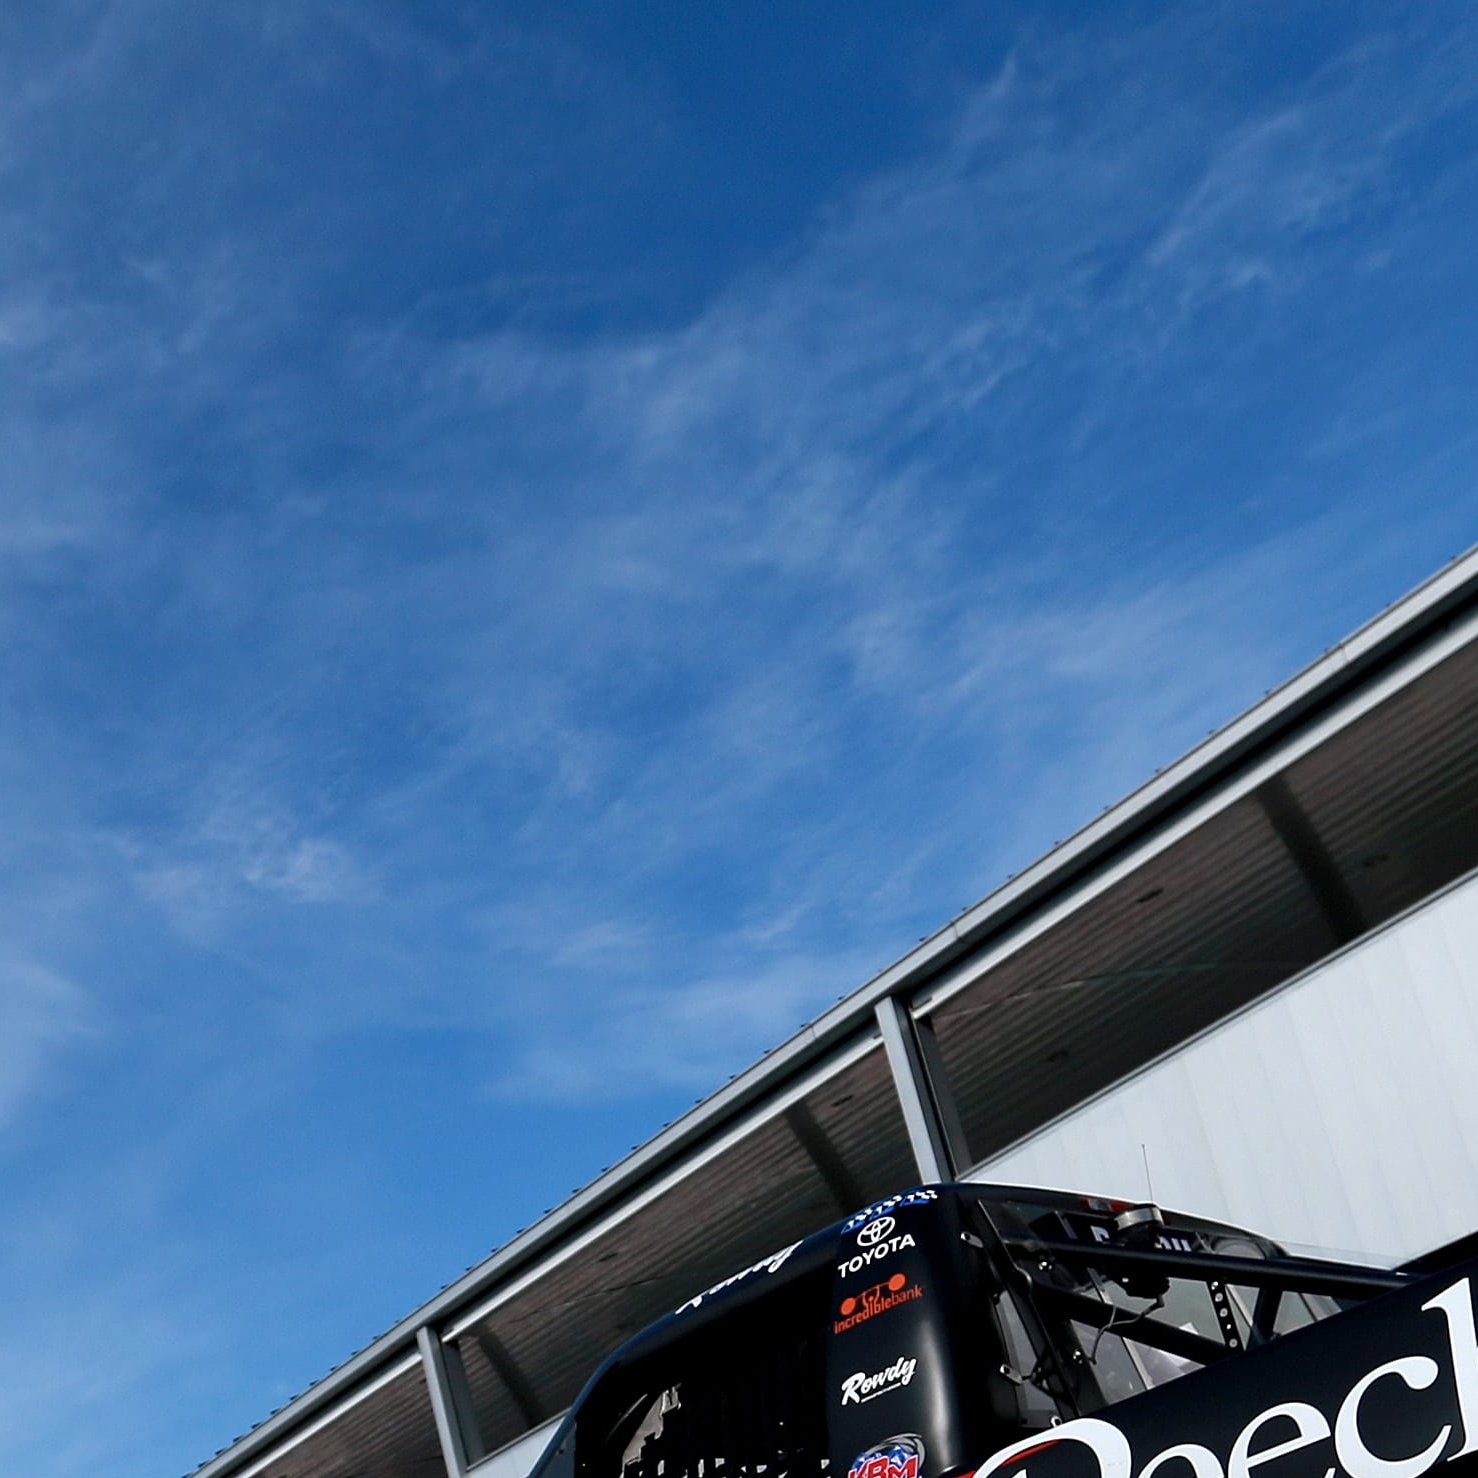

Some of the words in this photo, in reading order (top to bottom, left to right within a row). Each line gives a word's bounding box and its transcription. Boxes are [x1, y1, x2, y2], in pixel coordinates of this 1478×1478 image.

[837, 1234, 916, 1279] TOYOTA
[832, 1284, 923, 1335] incrediblebank
[841, 1356, 917, 1406] Rowdy
